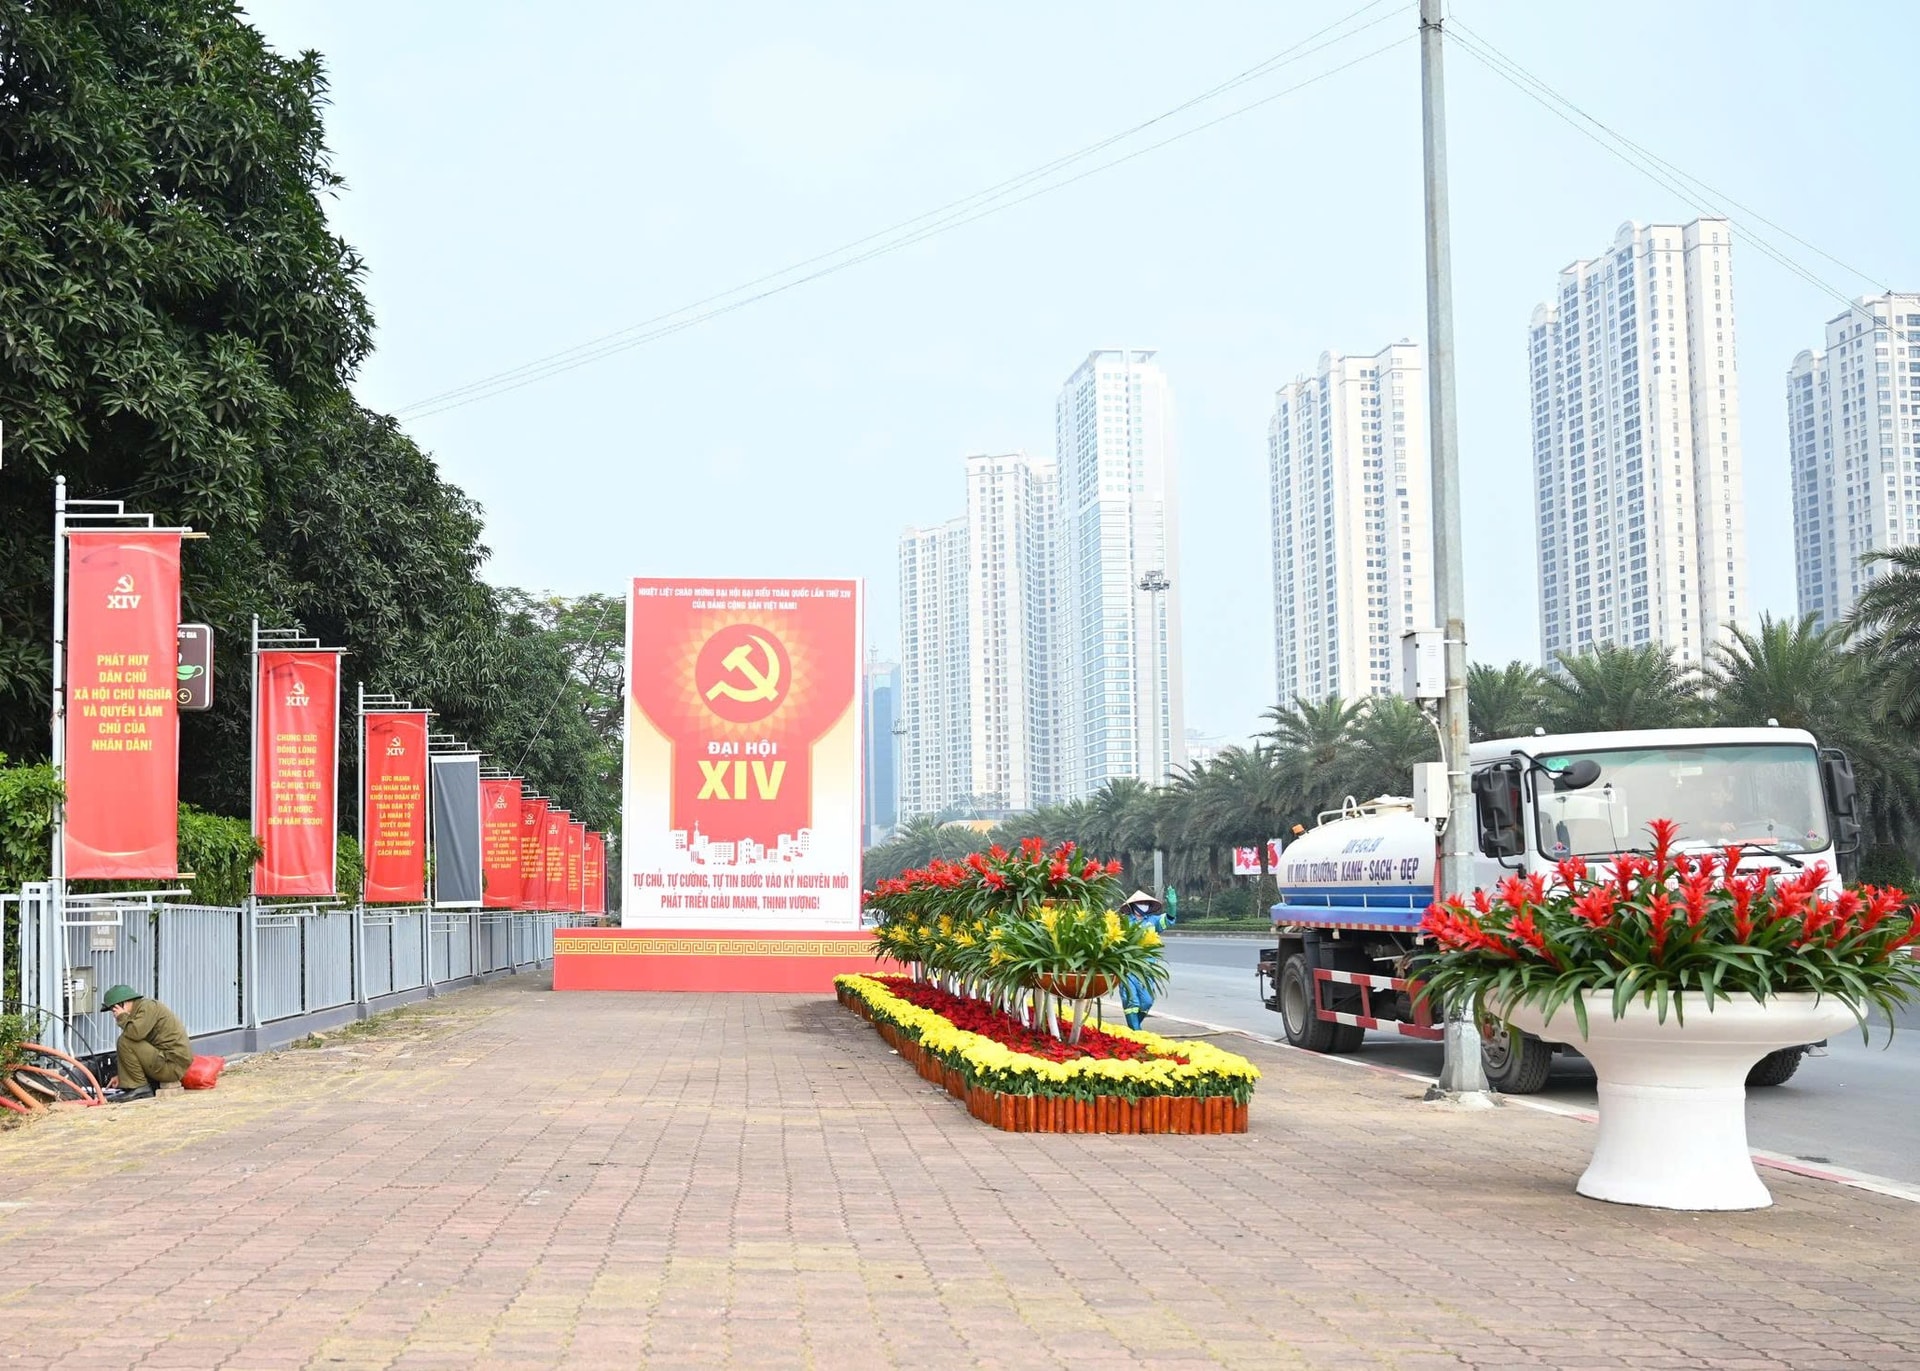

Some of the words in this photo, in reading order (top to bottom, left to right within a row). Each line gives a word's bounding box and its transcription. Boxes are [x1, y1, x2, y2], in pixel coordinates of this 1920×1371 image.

[107, 595, 141, 609] XIV
[97, 653, 126, 666] PHÁT
[128, 654, 149, 666] HUY
[99, 671, 123, 683] DÂN
[126, 670, 147, 683] CHỦ
[74, 688, 89, 700] XÃ
[92, 688, 110, 702] HỘI
[113, 687, 135, 700] CHỦ
[138, 688, 172, 700] NGHĨA
[286, 697, 310, 707] XIV
[83, 705, 97, 717] VÀ
[100, 704, 136, 717] QUYỀN
[139, 705, 163, 717] LÀM
[99, 720, 122, 734] CHỦ
[124, 720, 146, 734] CỦA
[92, 739, 123, 751] NHÂN
[126, 739, 152, 751] DÂN!
[708, 741, 738, 757] ĐẠI
[745, 738, 777, 758] HỘI
[697, 761, 787, 800] XIV
[1341, 860, 1363, 881] XANH
[1369, 859, 1392, 885] SẠCH
[1400, 858, 1419, 884] ĐẸP
[633, 872, 644, 890] TỰ
[646, 868, 664, 888] CHỦ,
[667, 873, 678, 890] TỰ
[680, 870, 710, 888] CƯỜNG,
[713, 874, 724, 890] TỰ
[725, 875, 738, 887] TIN
[740, 871, 763, 888] BƯỚC
[765, 872, 781, 888] VÀO
[784, 869, 794, 888] KỶ
[797, 873, 830, 888] NGUYÊN
[832, 872, 849, 888] MỚI
[661, 892, 682, 908] PHÁT
[684, 890, 708, 908] TRIỂN
[711, 893, 730, 908] GIÀU
[733, 896, 759, 912] MẠNH,
[762, 896, 787, 912] THỊNH
[789, 895, 820, 912] VƯỢNG!
